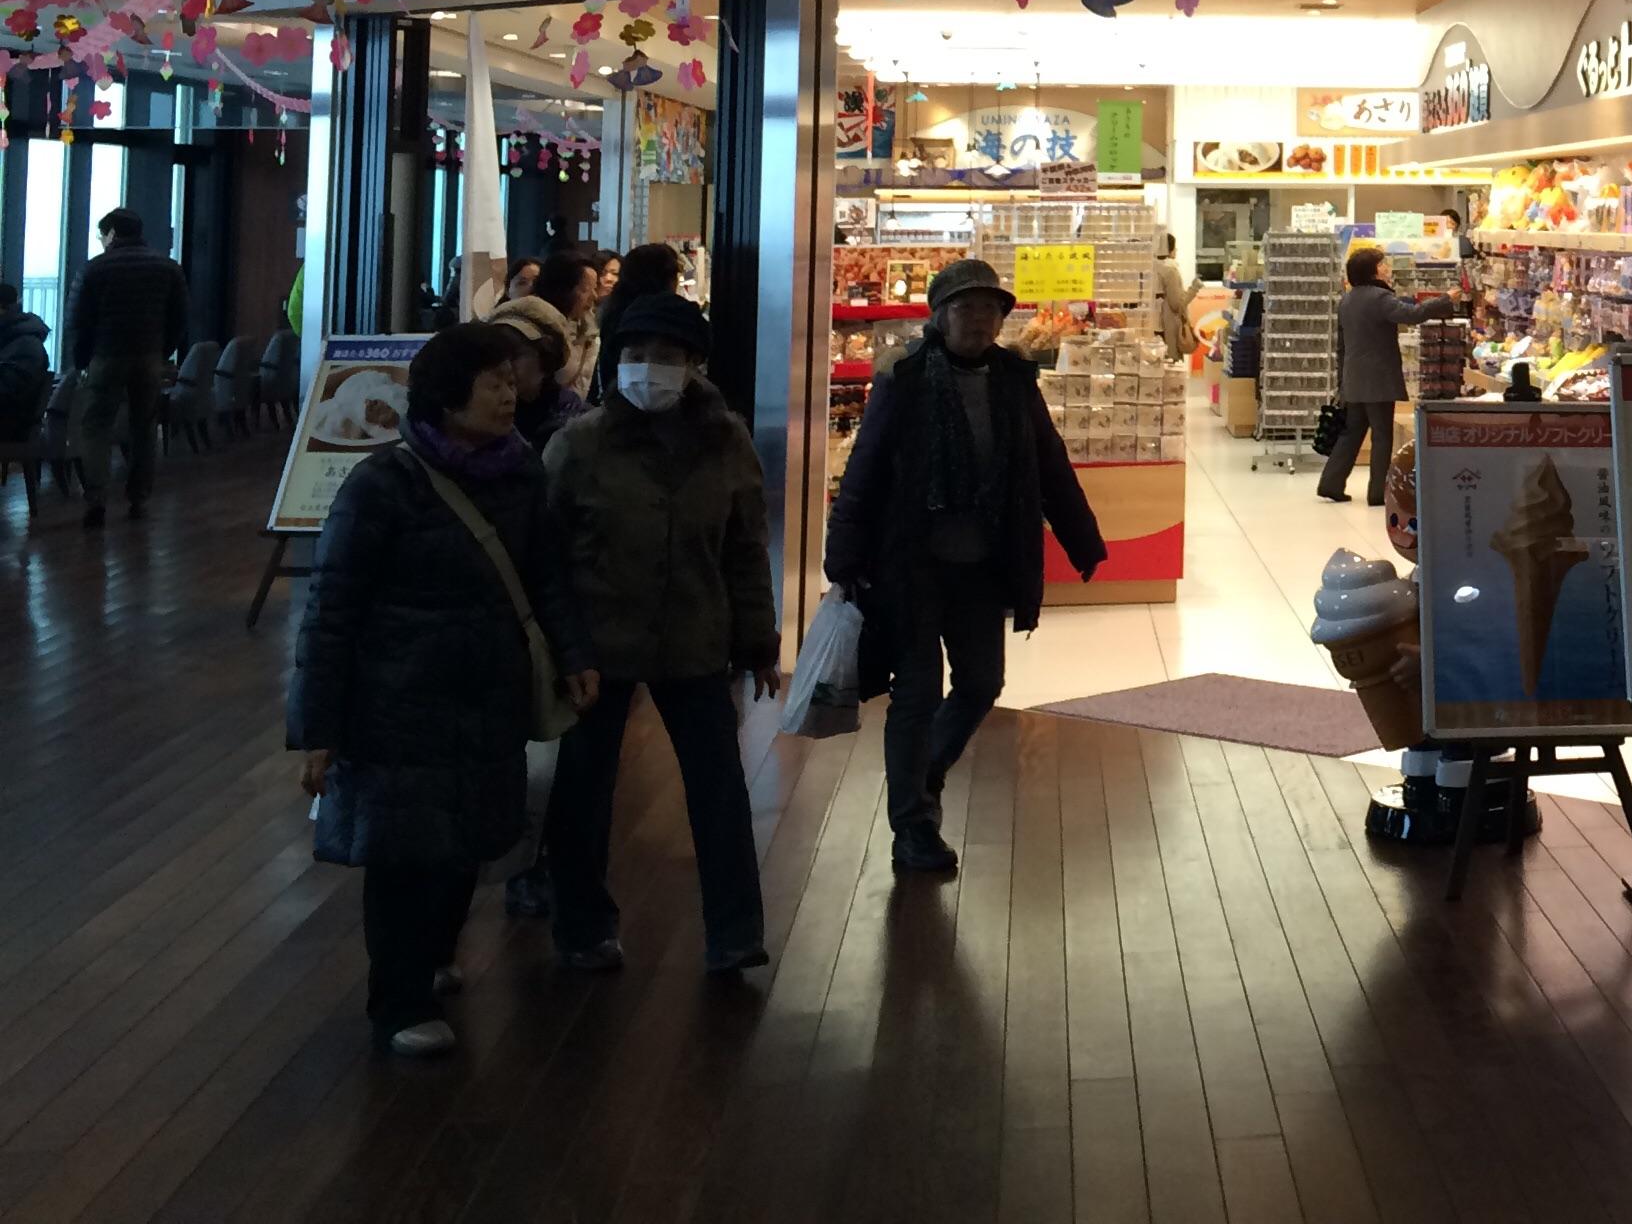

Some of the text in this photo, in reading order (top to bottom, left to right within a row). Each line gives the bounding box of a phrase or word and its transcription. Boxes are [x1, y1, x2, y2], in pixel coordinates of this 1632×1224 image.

[1353, 97, 1412, 123] あさり
[976, 129, 1079, 162] 海の技
